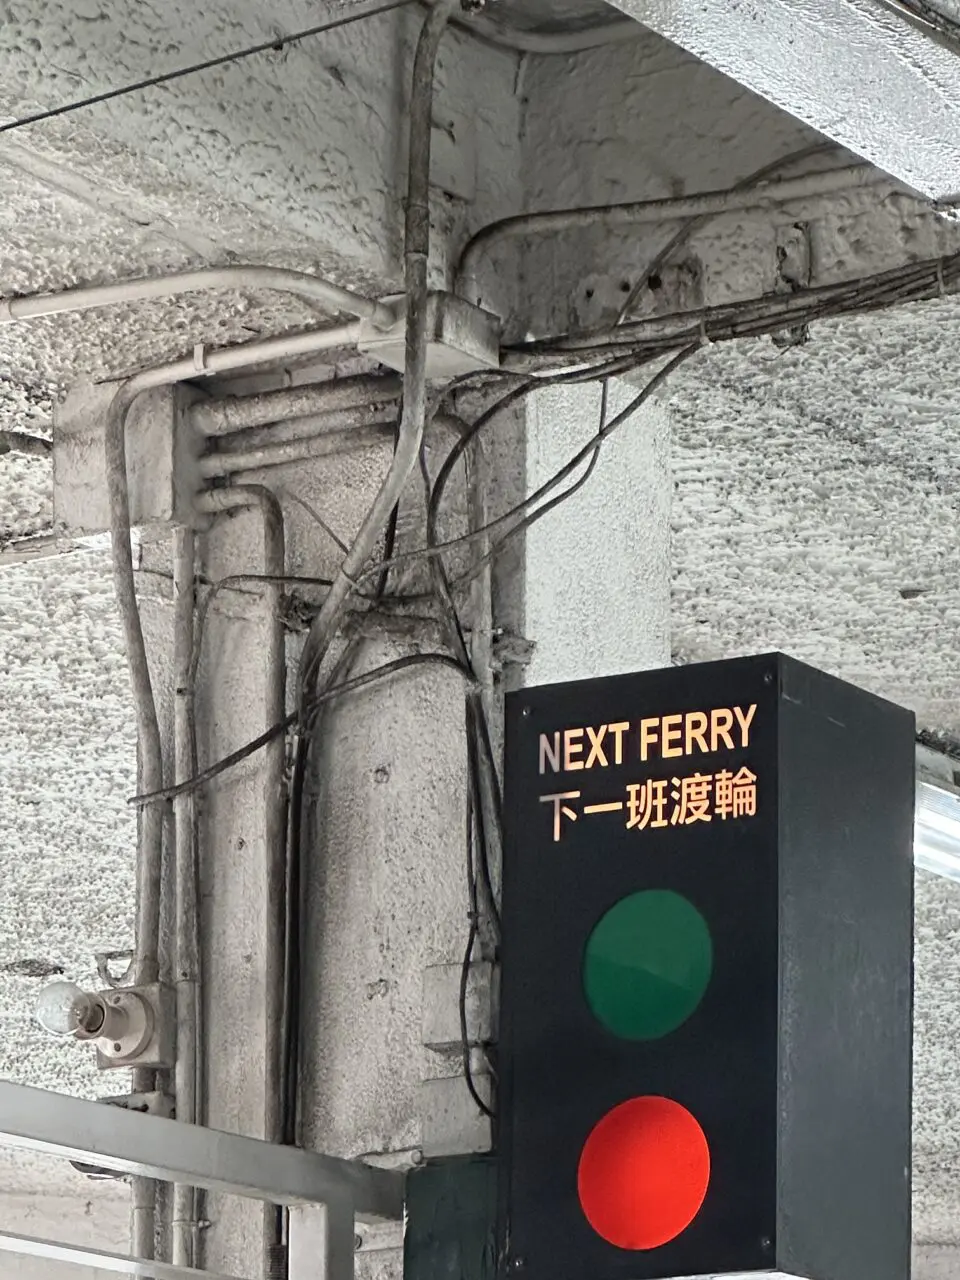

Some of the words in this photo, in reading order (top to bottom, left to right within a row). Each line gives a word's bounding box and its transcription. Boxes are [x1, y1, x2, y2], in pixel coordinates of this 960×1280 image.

[538, 720, 630, 774] NEXT
[639, 703, 758, 761] FERRY
[538, 766, 757, 842] 下一班渡輪
